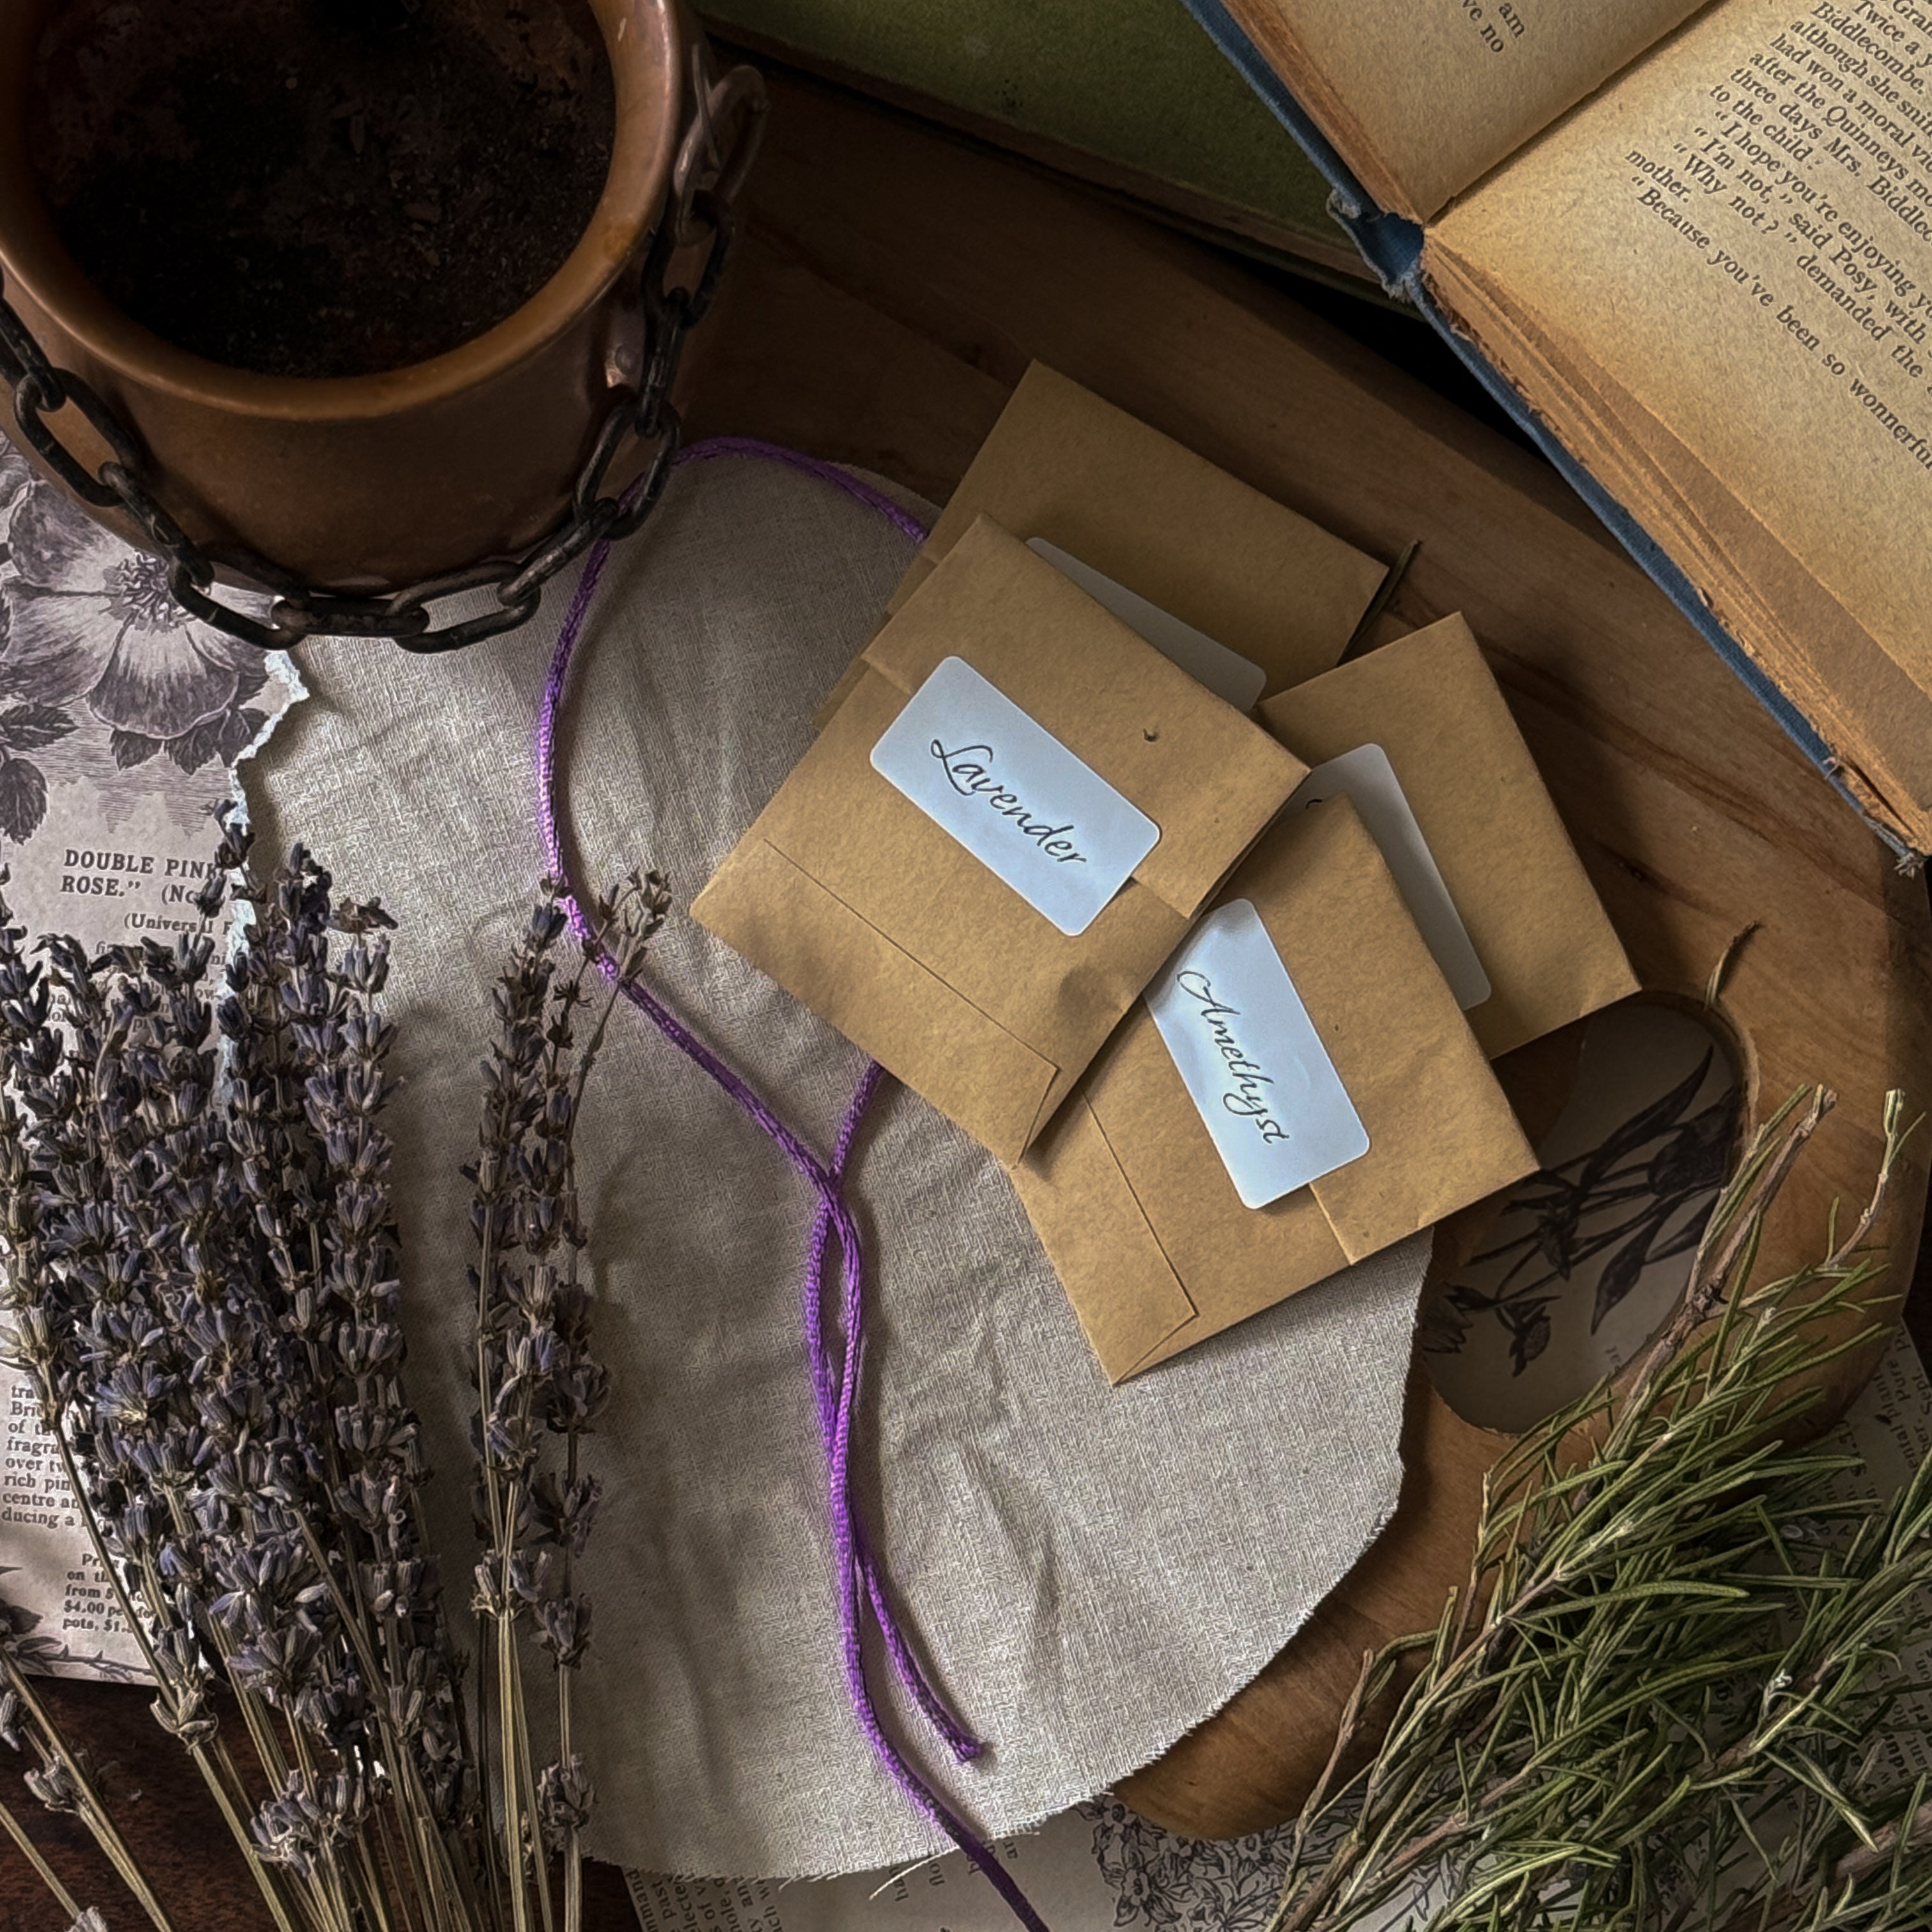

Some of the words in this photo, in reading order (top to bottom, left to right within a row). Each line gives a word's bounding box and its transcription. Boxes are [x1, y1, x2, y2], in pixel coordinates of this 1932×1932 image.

[1479, 23, 1504, 53] no
[1498, 2, 1525, 39] am
[1852, 0, 1905, 42] Twice
[1905, 41, 1920, 55] a
[1790, 20, 1868, 79] although
[1866, 74, 1899, 103] she
[1811, 2, 1924, 96] Biddlecombe.
[1709, 84, 1731, 103] to
[1731, 99, 1763, 126] the
[1770, 33, 1812, 65] had
[1805, 59, 1844, 93] won
[1843, 88, 1857, 103] a
[1855, 100, 1915, 148] moral
[1729, 67, 1777, 104] three
[1778, 102, 1823, 141] days
[1823, 137, 1862, 177] Mrs.
[1749, 52, 1797, 86] after
[1793, 80, 1826, 109] the
[1821, 105, 1909, 181] Quinneys
[1625, 150, 1692, 204] mother.
[1734, 131, 1781, 172] hope
[1774, 170, 1838, 222] you're
[1837, 221, 1917, 298] enjoying
[1788, 213, 1834, 250] said
[1828, 244, 1878, 300] Posy,
[1884, 299, 1927, 344] with
[1706, 249, 1774, 307] you've
[1776, 304, 1821, 351] been
[1821, 353, 1846, 376] so
[1796, 254, 1894, 342] demanded
[1890, 344, 1923, 378] the
[930, 738, 1087, 866] Lavender
[63, 849, 155, 875] DOUBLE
[1176, 969, 1290, 1145] Amethyst
[8, 1418, 27, 1434] of
[4, 1471, 36, 1488] rich
[5, 1457, 43, 1471] over
[1, 1506, 60, 1529] ducing
[65, 1515, 75, 1526] a
[2, 1492, 56, 1507] centre
[65, 1583, 101, 1598] from
[66, 1570, 85, 1581] on
[64, 1599, 105, 1615] $4.00
[651, 1879, 677, 1921] past
[696, 1902, 716, 1921] of
